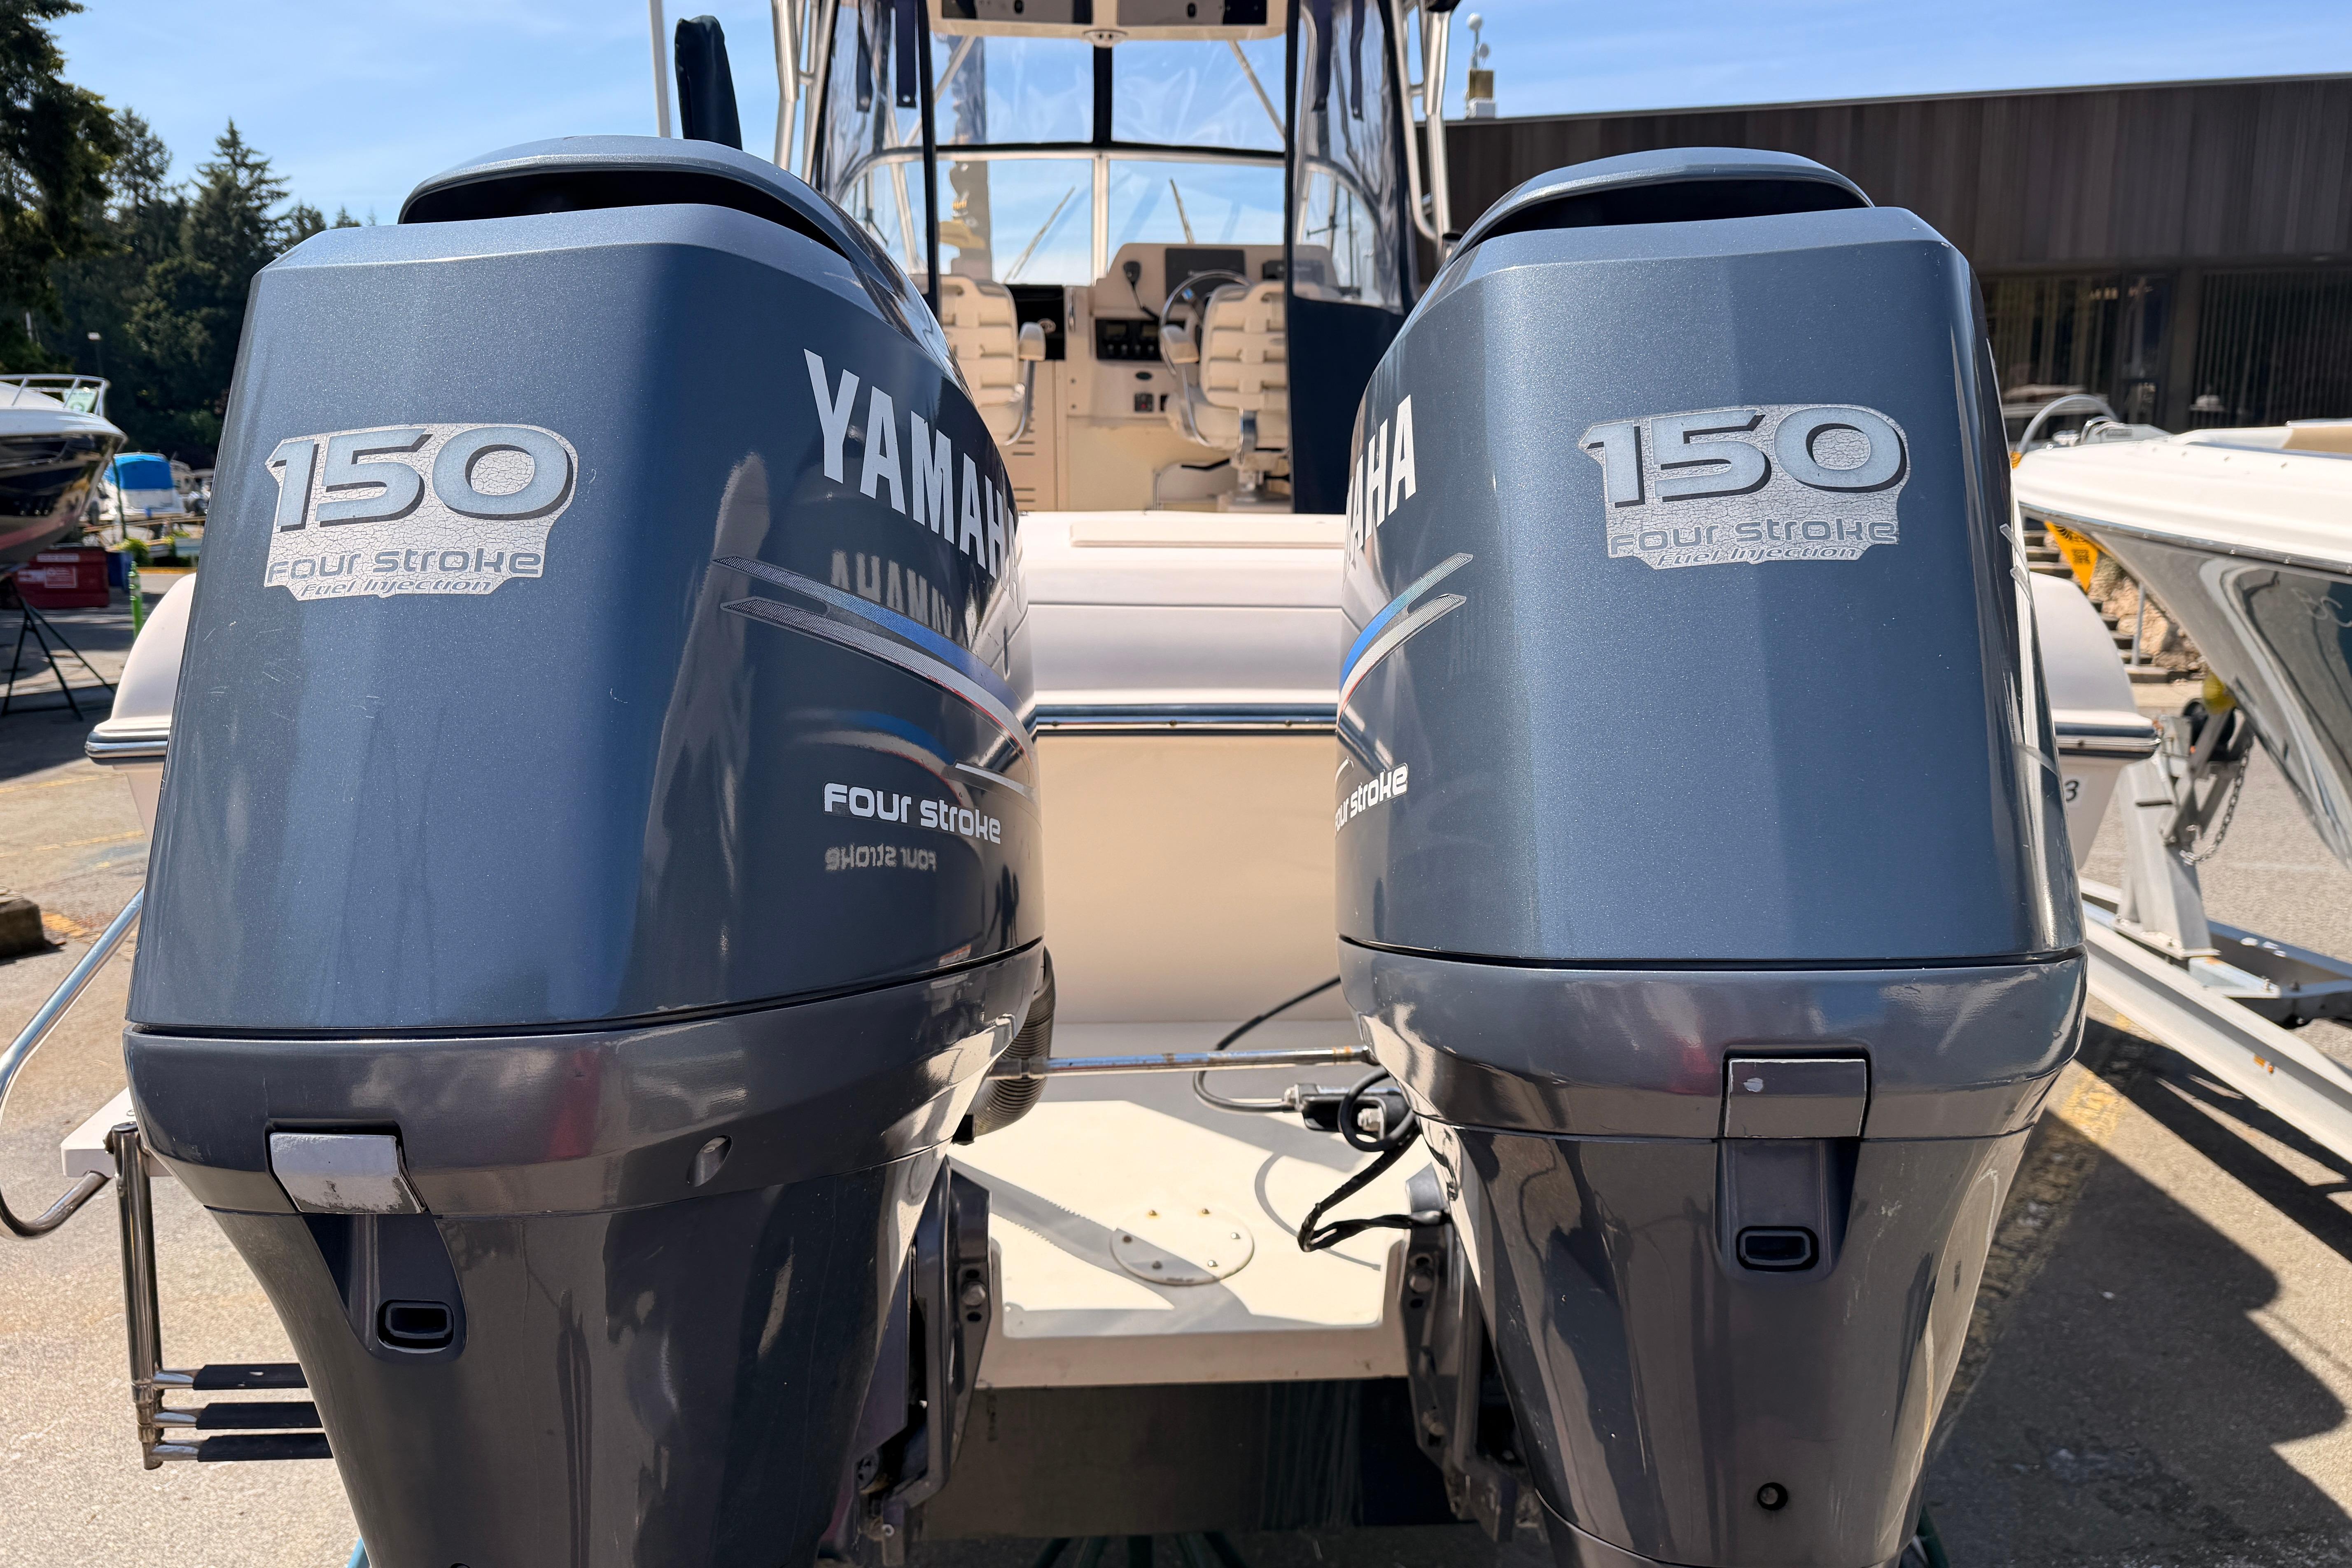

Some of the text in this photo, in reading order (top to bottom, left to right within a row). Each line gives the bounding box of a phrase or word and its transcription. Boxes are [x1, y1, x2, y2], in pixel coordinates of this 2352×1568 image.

[270, 427, 574, 532] 150
[803, 349, 1021, 614] YAMAHA
[1580, 406, 1907, 509] 150
[301, 578, 490, 597] Fuel Injection
[1656, 547, 1857, 566] Fuel Injection
[2064, 779, 2079, 802] 3
